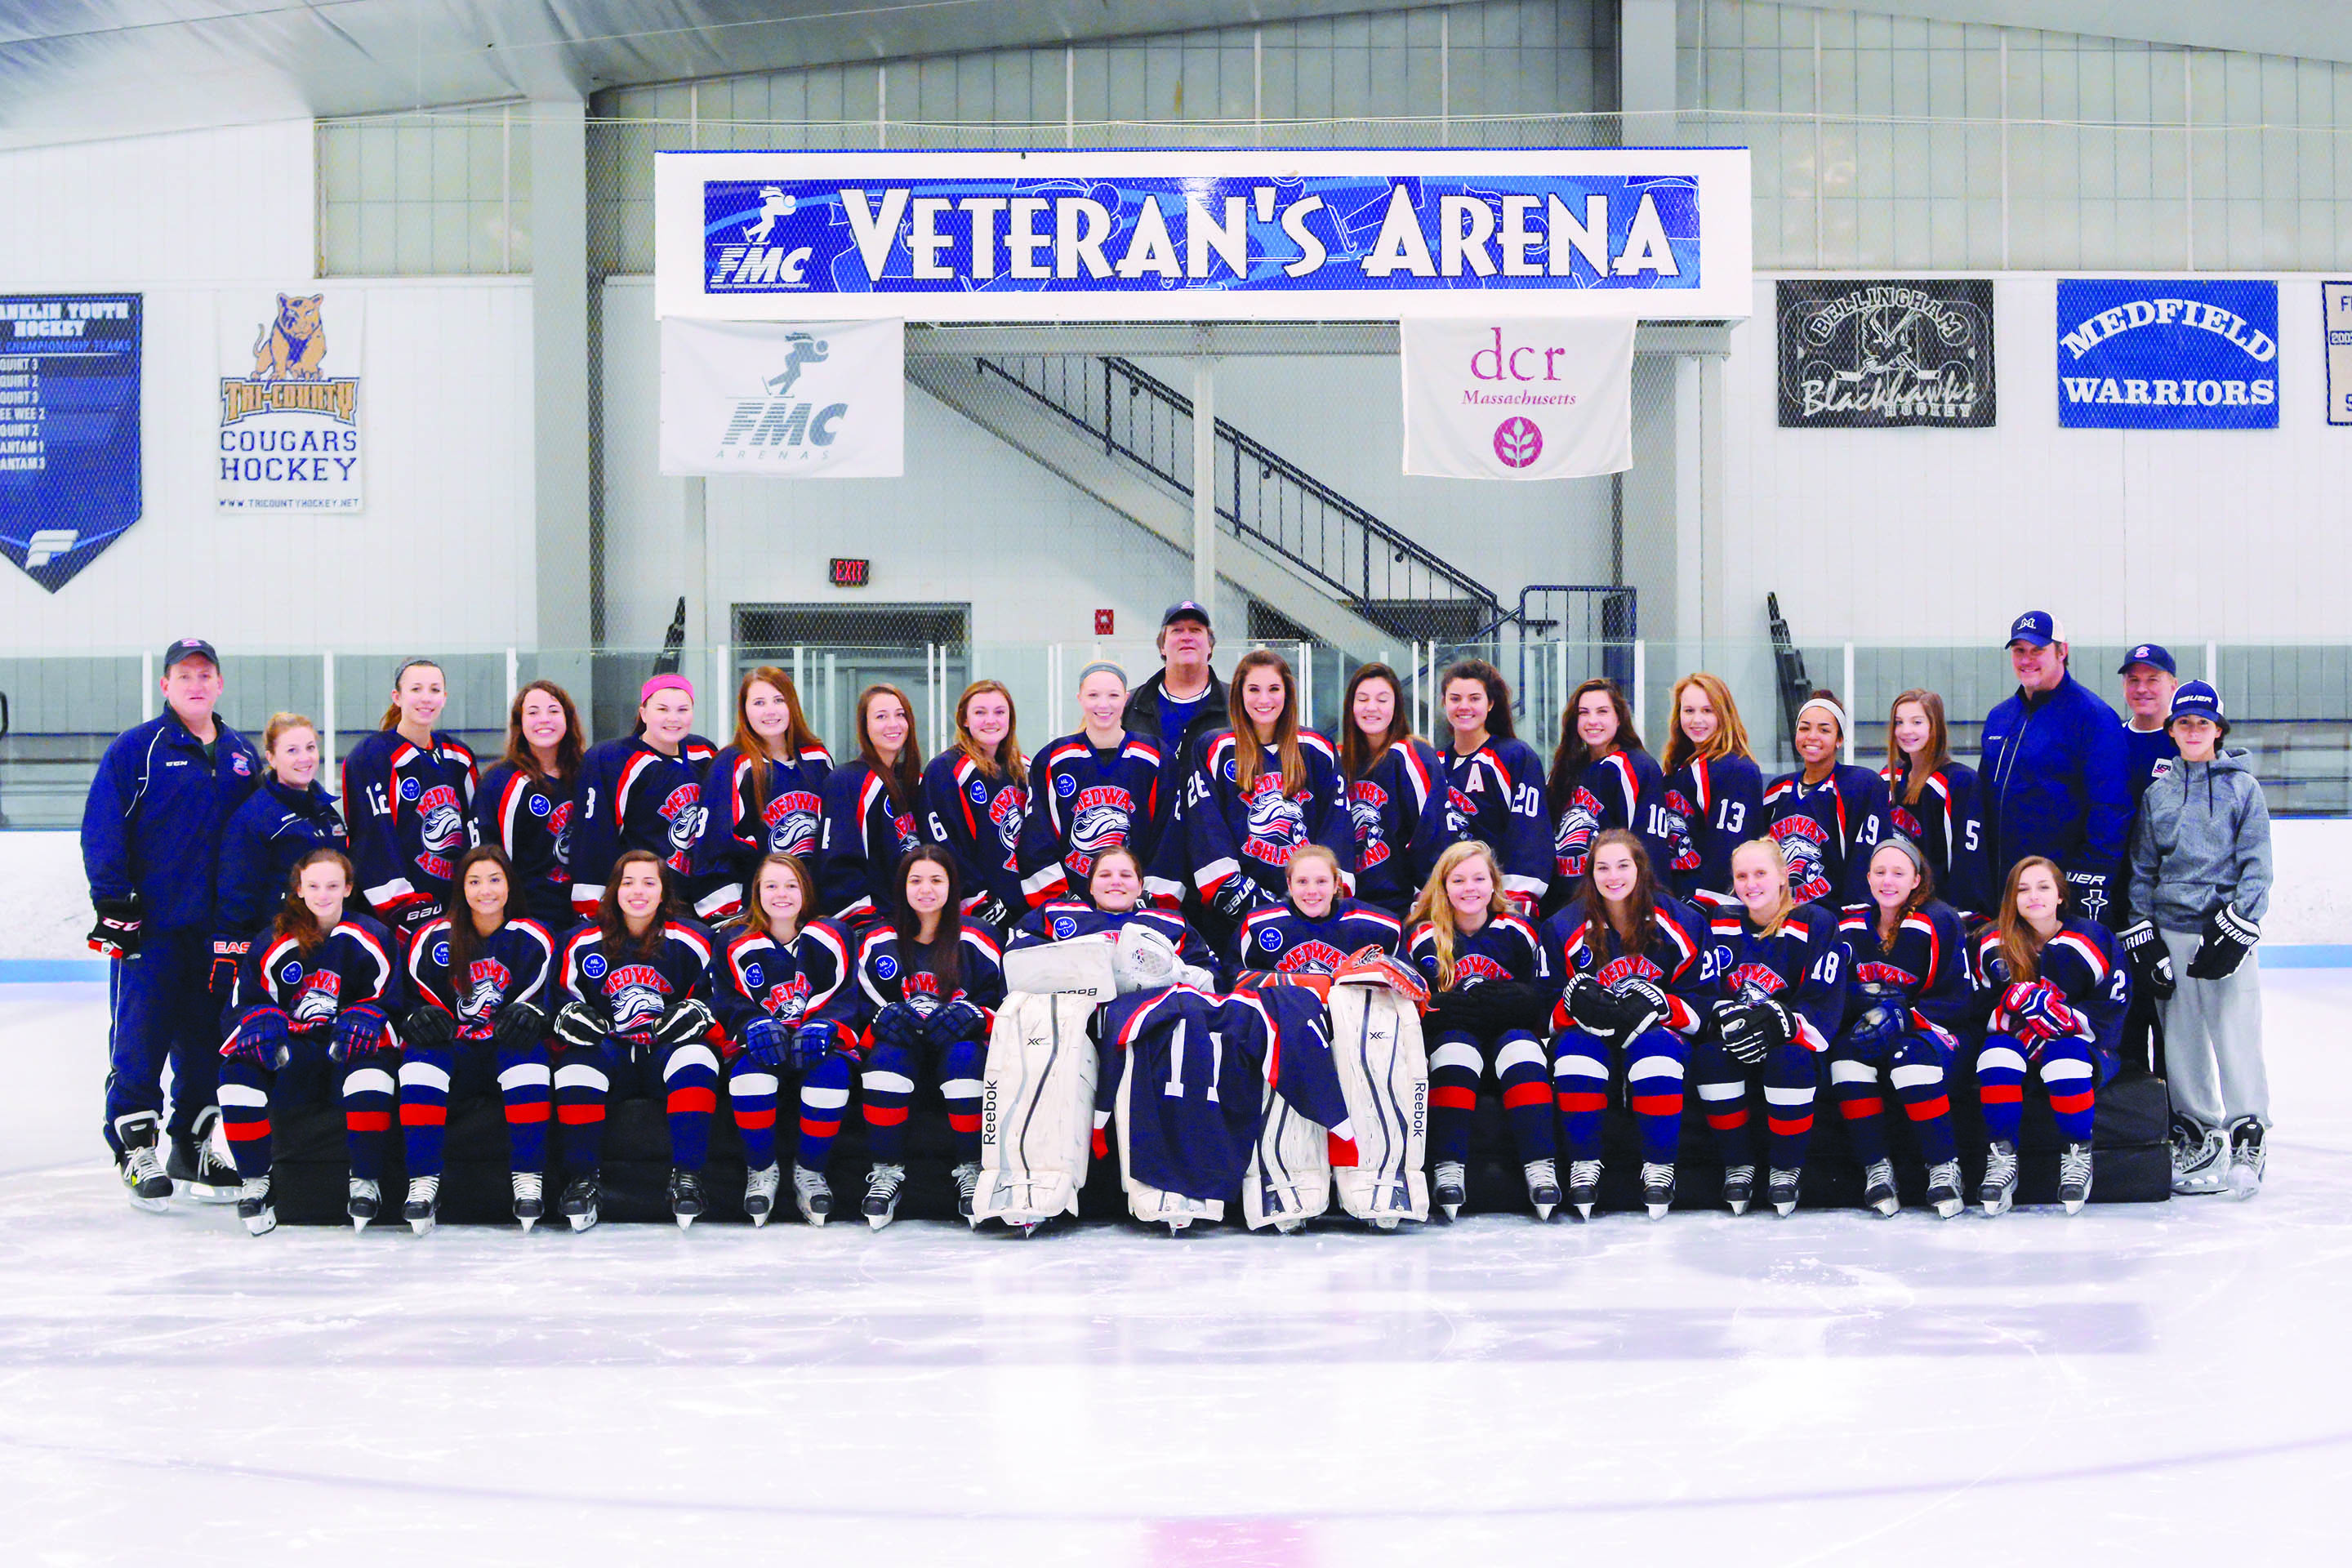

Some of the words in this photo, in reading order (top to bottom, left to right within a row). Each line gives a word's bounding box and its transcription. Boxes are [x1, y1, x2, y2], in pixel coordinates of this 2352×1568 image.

[839, 186, 1327, 282] VETERAN'S
[1361, 184, 1681, 278] ARENA
[710, 247, 813, 283] FMC
[67, 302, 129, 319] YOUTH
[1811, 287, 1963, 339] BELLINGHAM
[14, 320, 86, 337] HOCKEY
[2060, 298, 2277, 363] MEDFIELD
[1470, 327, 1566, 381] dcr
[32, 375, 39, 388] 2
[1461, 389, 1577, 406] Massachusetts
[1801, 370, 1977, 416] Blackhawks
[2061, 377, 2275, 407] WARRIORS
[15, 407, 37, 421] WEE
[38, 407, 46, 421] 2
[225, 381, 355, 422] TRI-COUNTY
[1885, 403, 1971, 418] HOCKEY
[32, 423, 39, 437] 2
[220, 430, 358, 452] COUGARS
[721, 403, 849, 447] FMC
[220, 457, 358, 481] HOCKEY
[715, 450, 831, 461] ARENAS
[835, 559, 864, 582] EXIT
[1464, 763, 1485, 793] A
[1511, 782, 1539, 817] 20
[929, 811, 948, 842] 6
[1646, 803, 1668, 839] 10
[1716, 799, 1746, 833] 13
[1965, 819, 1981, 851] 5
[1811, 951, 1840, 984] 18
[1165, 1019, 1223, 1102] 11
[983, 1079, 999, 1146] Reebok
[1414, 1082, 1428, 1138] Reebok
